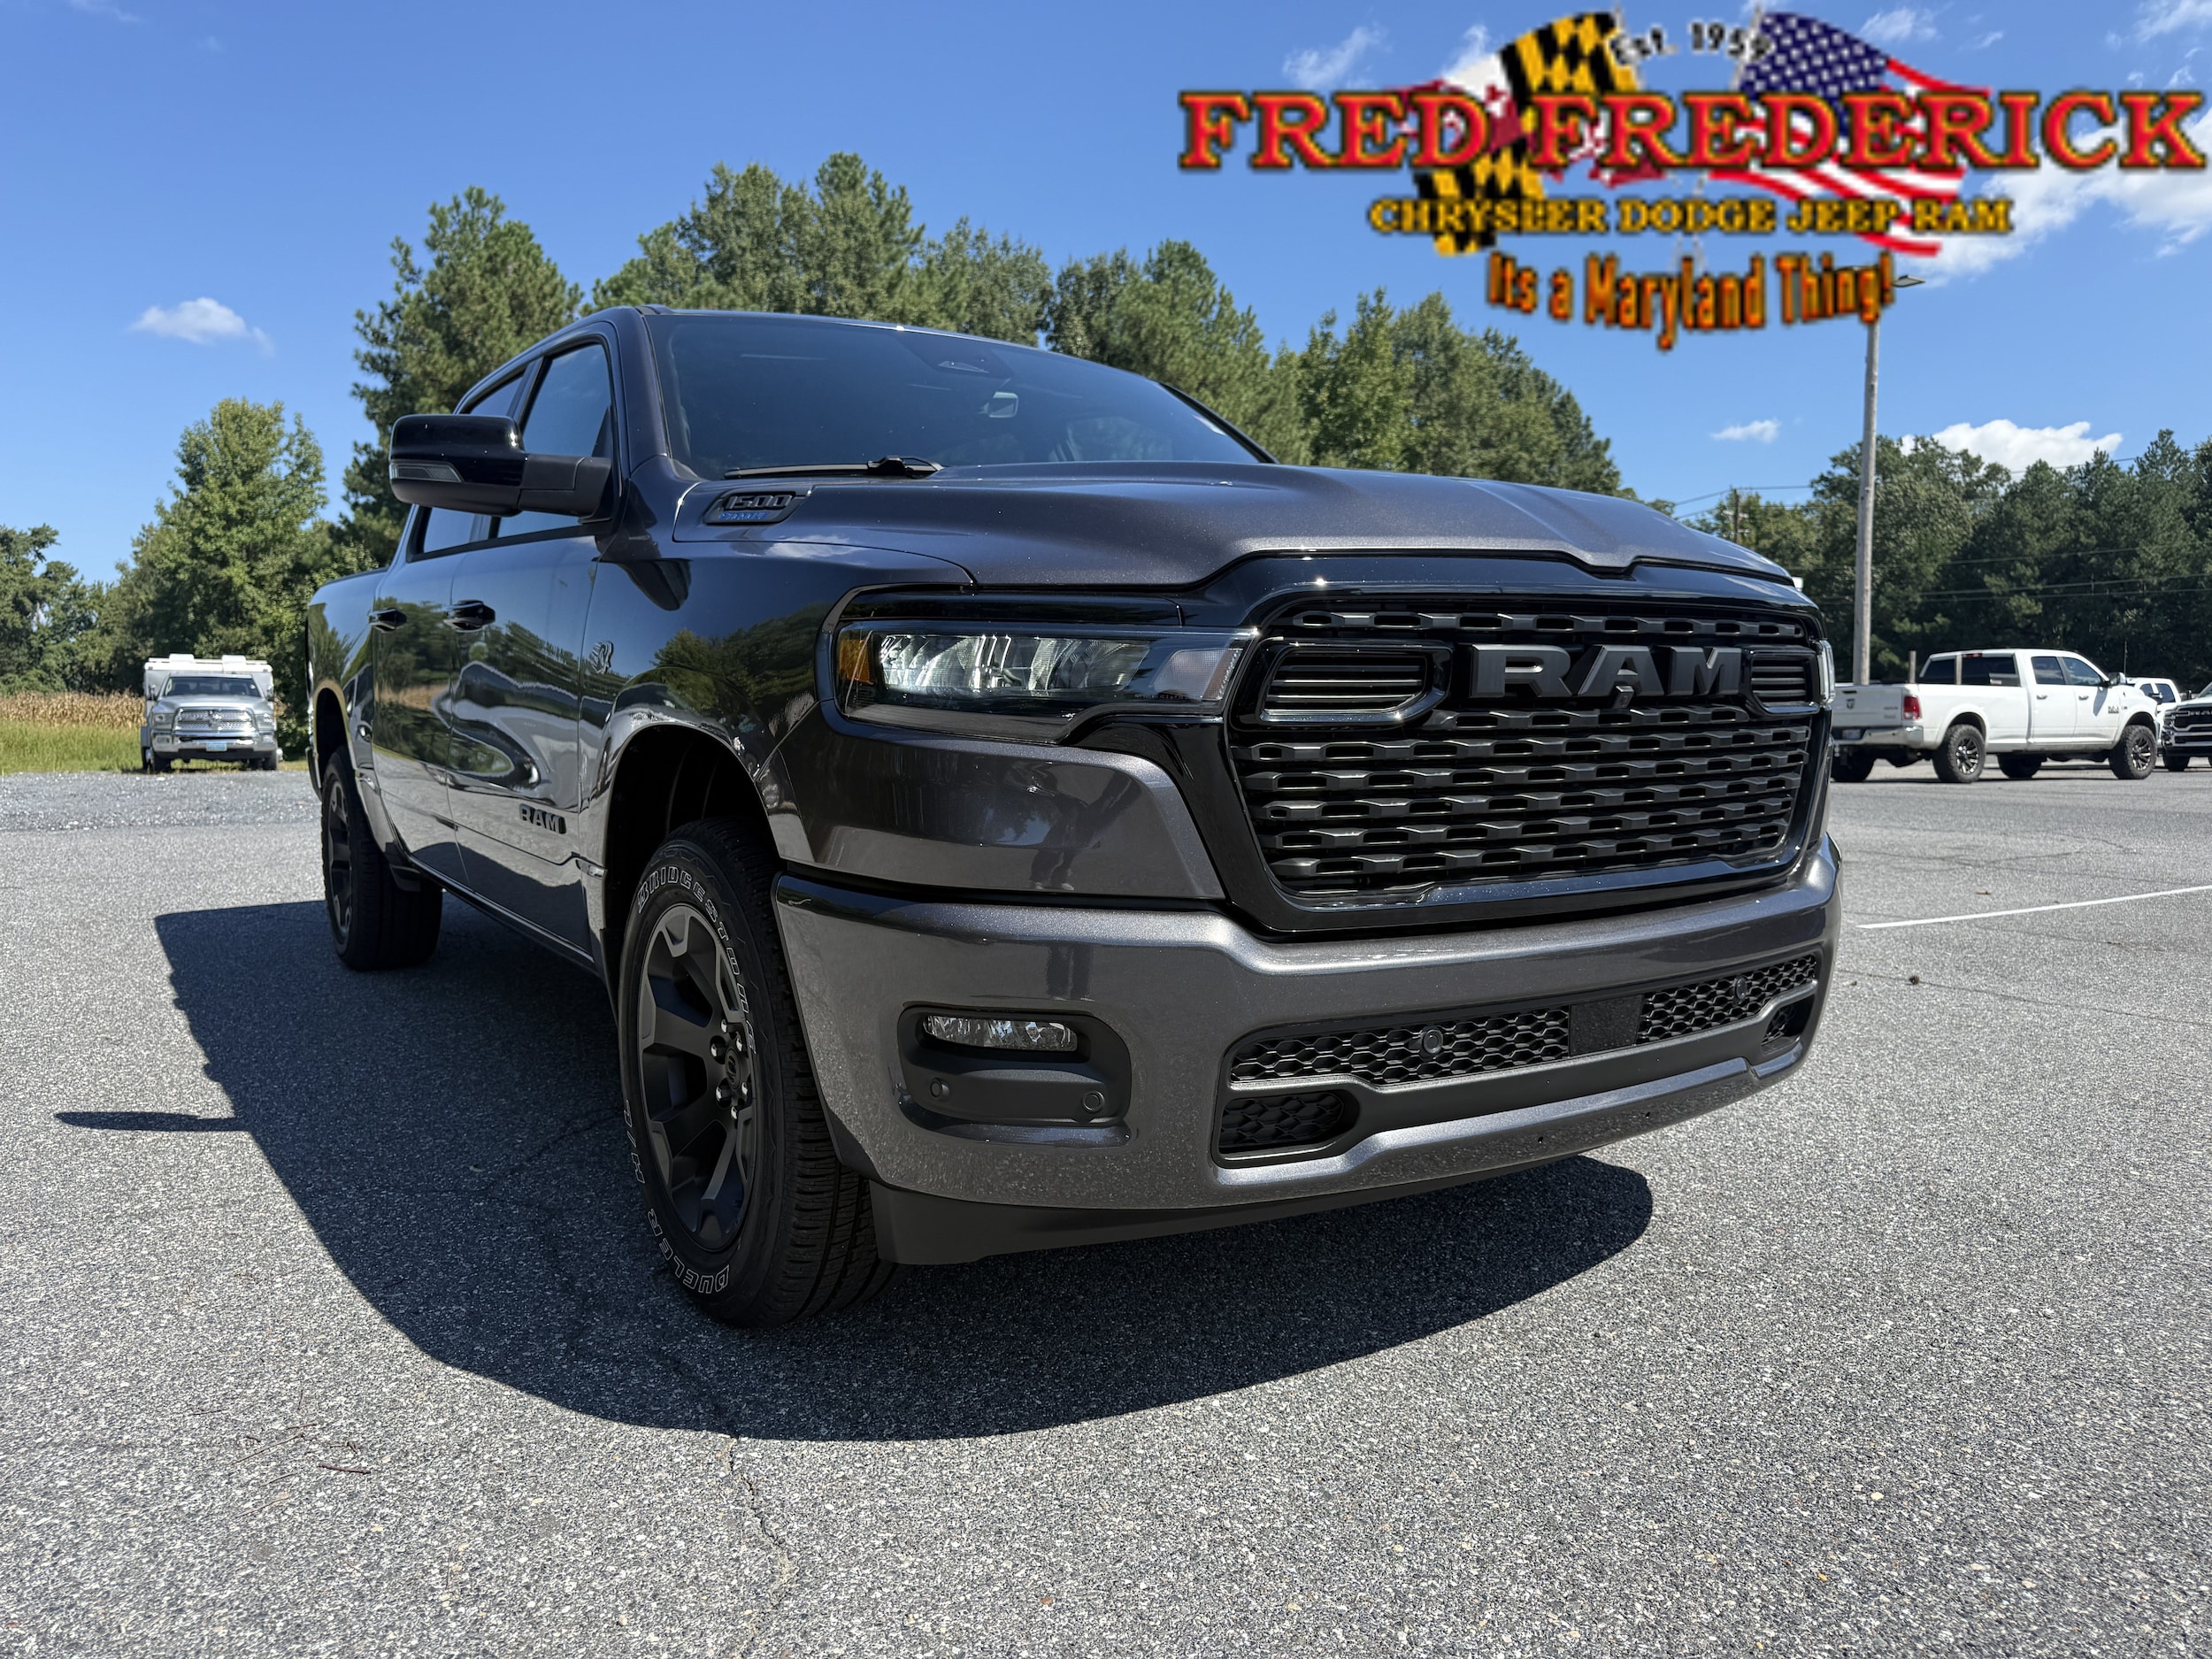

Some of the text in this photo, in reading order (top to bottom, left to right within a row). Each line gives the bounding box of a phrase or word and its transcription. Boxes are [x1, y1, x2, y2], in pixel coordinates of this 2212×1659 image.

[727, 495, 793, 510] 1500
[1471, 643, 1743, 698] RAM
[519, 803, 567, 834] RAM
[637, 866, 757, 1056] BRIDGESTONE
[647, 1208, 730, 1294] DUELER
